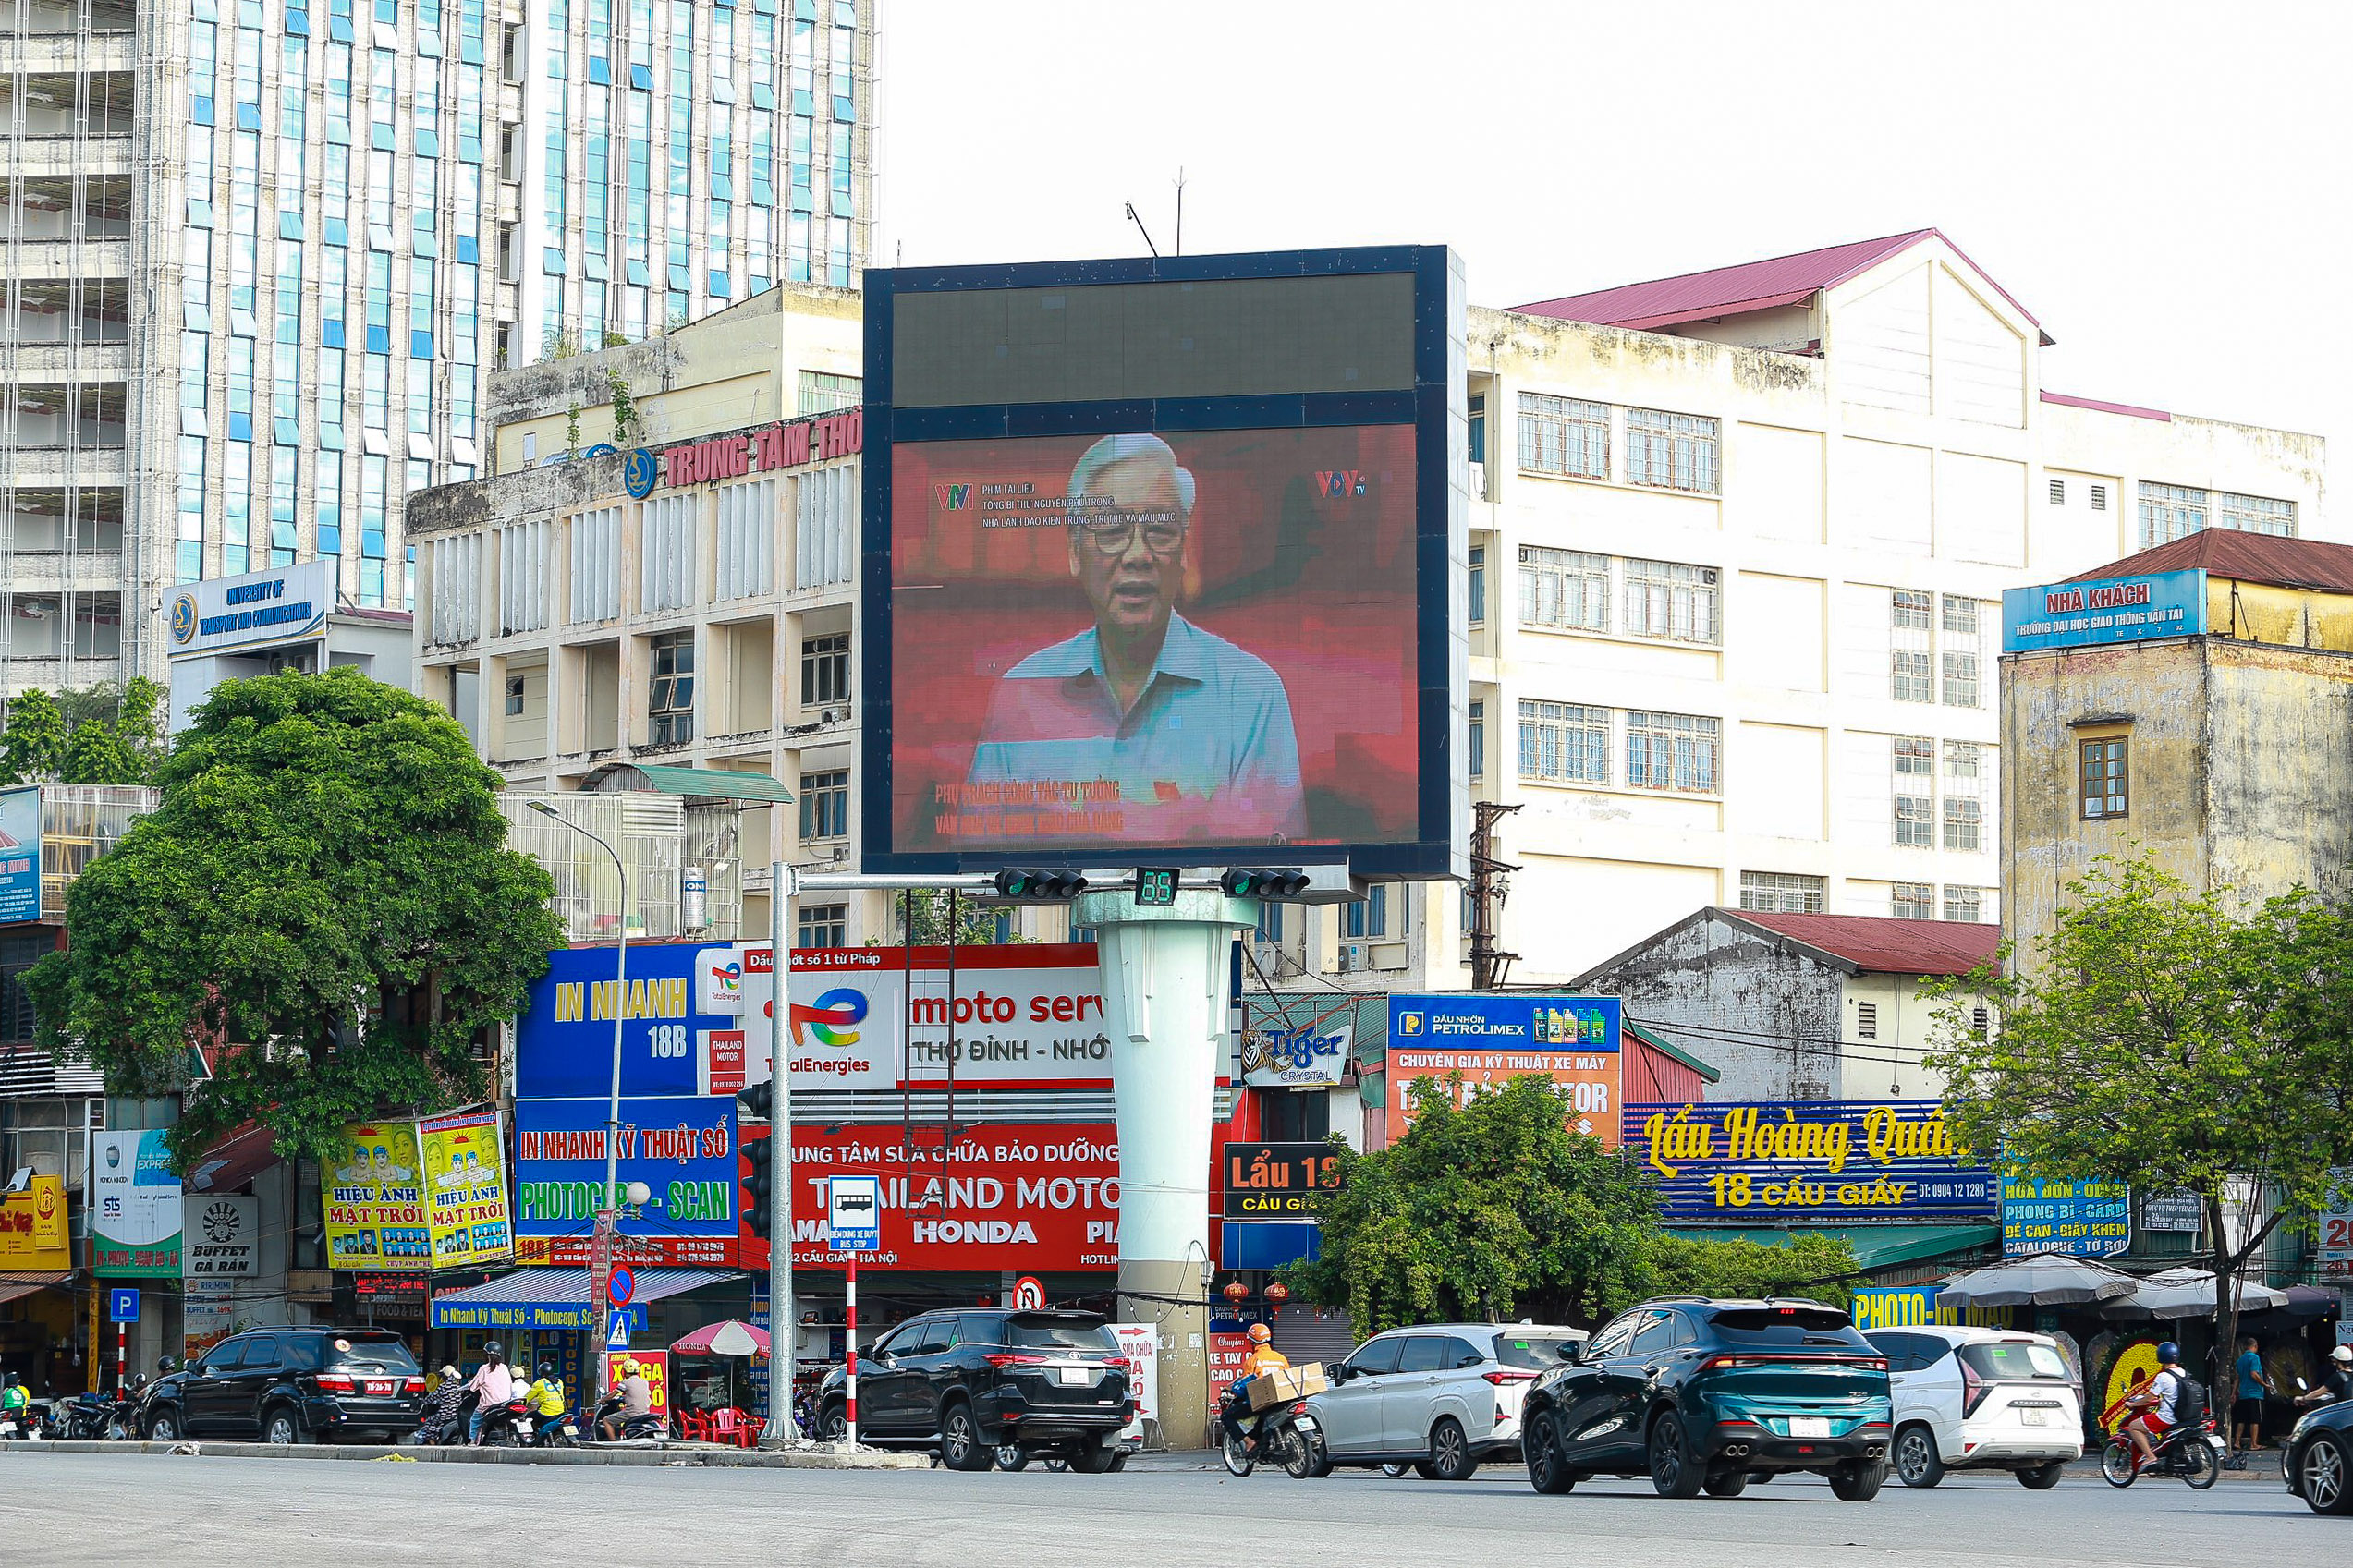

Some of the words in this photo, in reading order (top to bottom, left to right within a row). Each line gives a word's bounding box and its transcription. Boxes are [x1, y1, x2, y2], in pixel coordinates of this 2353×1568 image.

[664, 436, 749, 487] TRUNG
[754, 419, 810, 471] TÂM
[981, 483, 1001, 495] PHIM
[226, 581, 272, 606] UNIVERSITY
[273, 579, 284, 599] OF
[2046, 588, 2085, 614] NHÀ
[2088, 583, 2150, 610] KHÁCH
[200, 613, 238, 636] TRANSPORT
[238, 611, 251, 630] AND
[253, 602, 311, 627] COMMUNICATIONS
[2053, 619, 2069, 635] ĐẠI
[2070, 618, 2089, 634] HỌC
[2091, 616, 2113, 629] GIAO
[2115, 612, 2145, 626] THÔNG
[2147, 611, 2166, 626] VẬN
[2168, 603, 2184, 621] TẢI
[1141, 871, 1172, 902] 65
[750, 953, 773, 966] Dầu
[807, 953, 821, 965] số
[824, 954, 831, 965] 1
[834, 953, 847, 965] từ
[850, 952, 880, 966] Pháp
[555, 982, 584, 1022] IN
[591, 978, 687, 1021] NHANH
[712, 992, 741, 1002] TotalEnergies
[913, 991, 1015, 1025] moto
[1433, 1013, 1456, 1024] DẦU
[1457, 1013, 1485, 1023] NHỜN
[1433, 1024, 1525, 1035] PETROLIMEX
[648, 1025, 687, 1058] 18B
[713, 1040, 742, 1051] THAILAND
[913, 1038, 962, 1067] THỢ
[968, 1035, 1029, 1062] ĐỈNH
[1267, 1026, 1345, 1069] Tiger
[716, 1051, 738, 1062] MOTOR
[1399, 1052, 1454, 1068] CHUYÊN
[1457, 1055, 1481, 1068] GIA
[1484, 1052, 1504, 1068] KỸ
[1506, 1053, 1551, 1071] THUẬT
[1554, 1056, 1571, 1069] XE
[1576, 1053, 1606, 1070] MÁY
[765, 1057, 870, 1076] TalEnergies
[1280, 1070, 1332, 1082] CRYSTAL
[520, 1131, 541, 1160] IN
[543, 1130, 607, 1160] NHANH
[616, 1124, 636, 1160] KỸ
[641, 1122, 698, 1164] THUẬT
[702, 1114, 728, 1158] SỐ
[1643, 1104, 1714, 1179] Lẩu
[1723, 1107, 1853, 1173] Hoàng
[837, 1141, 880, 1163] TÂM
[933, 1139, 989, 1162] CHỮA
[995, 1139, 1040, 1161] BẢO
[1044, 1136, 1118, 1162] DƯỠNG
[1232, 1149, 1290, 1188] Lẩu
[333, 1185, 374, 1205] HIỆU
[380, 1183, 419, 1202] ẢNH
[436, 1188, 468, 1209] HIỆU
[470, 1184, 499, 1204] ẢNH
[1707, 1173, 1751, 1208] 18
[1762, 1175, 1831, 1206] CẦU
[1836, 1173, 1908, 1205] GIẤY
[1919, 1185, 1931, 1198] ĐT:
[1932, 1185, 1952, 1197] 0904
[1954, 1185, 1964, 1197] 12
[1965, 1183, 1985, 1197] 1288
[667, 1181, 730, 1220] SCAN
[1242, 1192, 1281, 1210] CẦU
[2005, 1204, 2054, 1220] PHONG
[2059, 1200, 2075, 1219] BÌ
[2085, 1203, 2126, 1218] CARD
[329, 1203, 372, 1226] MẶT
[376, 1201, 425, 1223] TRỜI
[433, 1206, 465, 1228] MẶT
[468, 1201, 505, 1222] TRỜI
[913, 1220, 1038, 1245] HONDA
[2025, 1224, 2052, 1238] CAN
[2059, 1219, 2089, 1237] GIẤY
[2092, 1223, 2126, 1236] KHEN
[192, 1246, 250, 1257] BUFFET
[839, 1240, 851, 1248] BUS
[853, 1240, 867, 1248] STOP
[2005, 1240, 2076, 1254] CATALOGUE
[2085, 1238, 2102, 1252] TỜ
[194, 1258, 213, 1273] GÀ
[217, 1258, 249, 1272] RÁN
[802, 1249, 824, 1263] CẦU
[860, 1250, 875, 1263] HÀ
[879, 1250, 897, 1266] NỘI
[120, 1297, 131, 1314] P
[377, 1304, 399, 1316] FOOD
[408, 1305, 424, 1316] TEA
[441, 1307, 448, 1323] In
[450, 1307, 476, 1323] Nhanh
[477, 1307, 488, 1326] Kỹ
[491, 1307, 512, 1327] Thuật
[514, 1306, 526, 1325] Số
[678, 1343, 706, 1351] HONDA
[1122, 1339, 1134, 1356] SỬA
[1136, 1341, 1152, 1356] CHỮA
[1218, 1337, 1244, 1348] Chuyên:
[1224, 1353, 1242, 1364] TAY
[640, 1363, 664, 1382] GA
[1211, 1369, 1233, 1381] CAO
